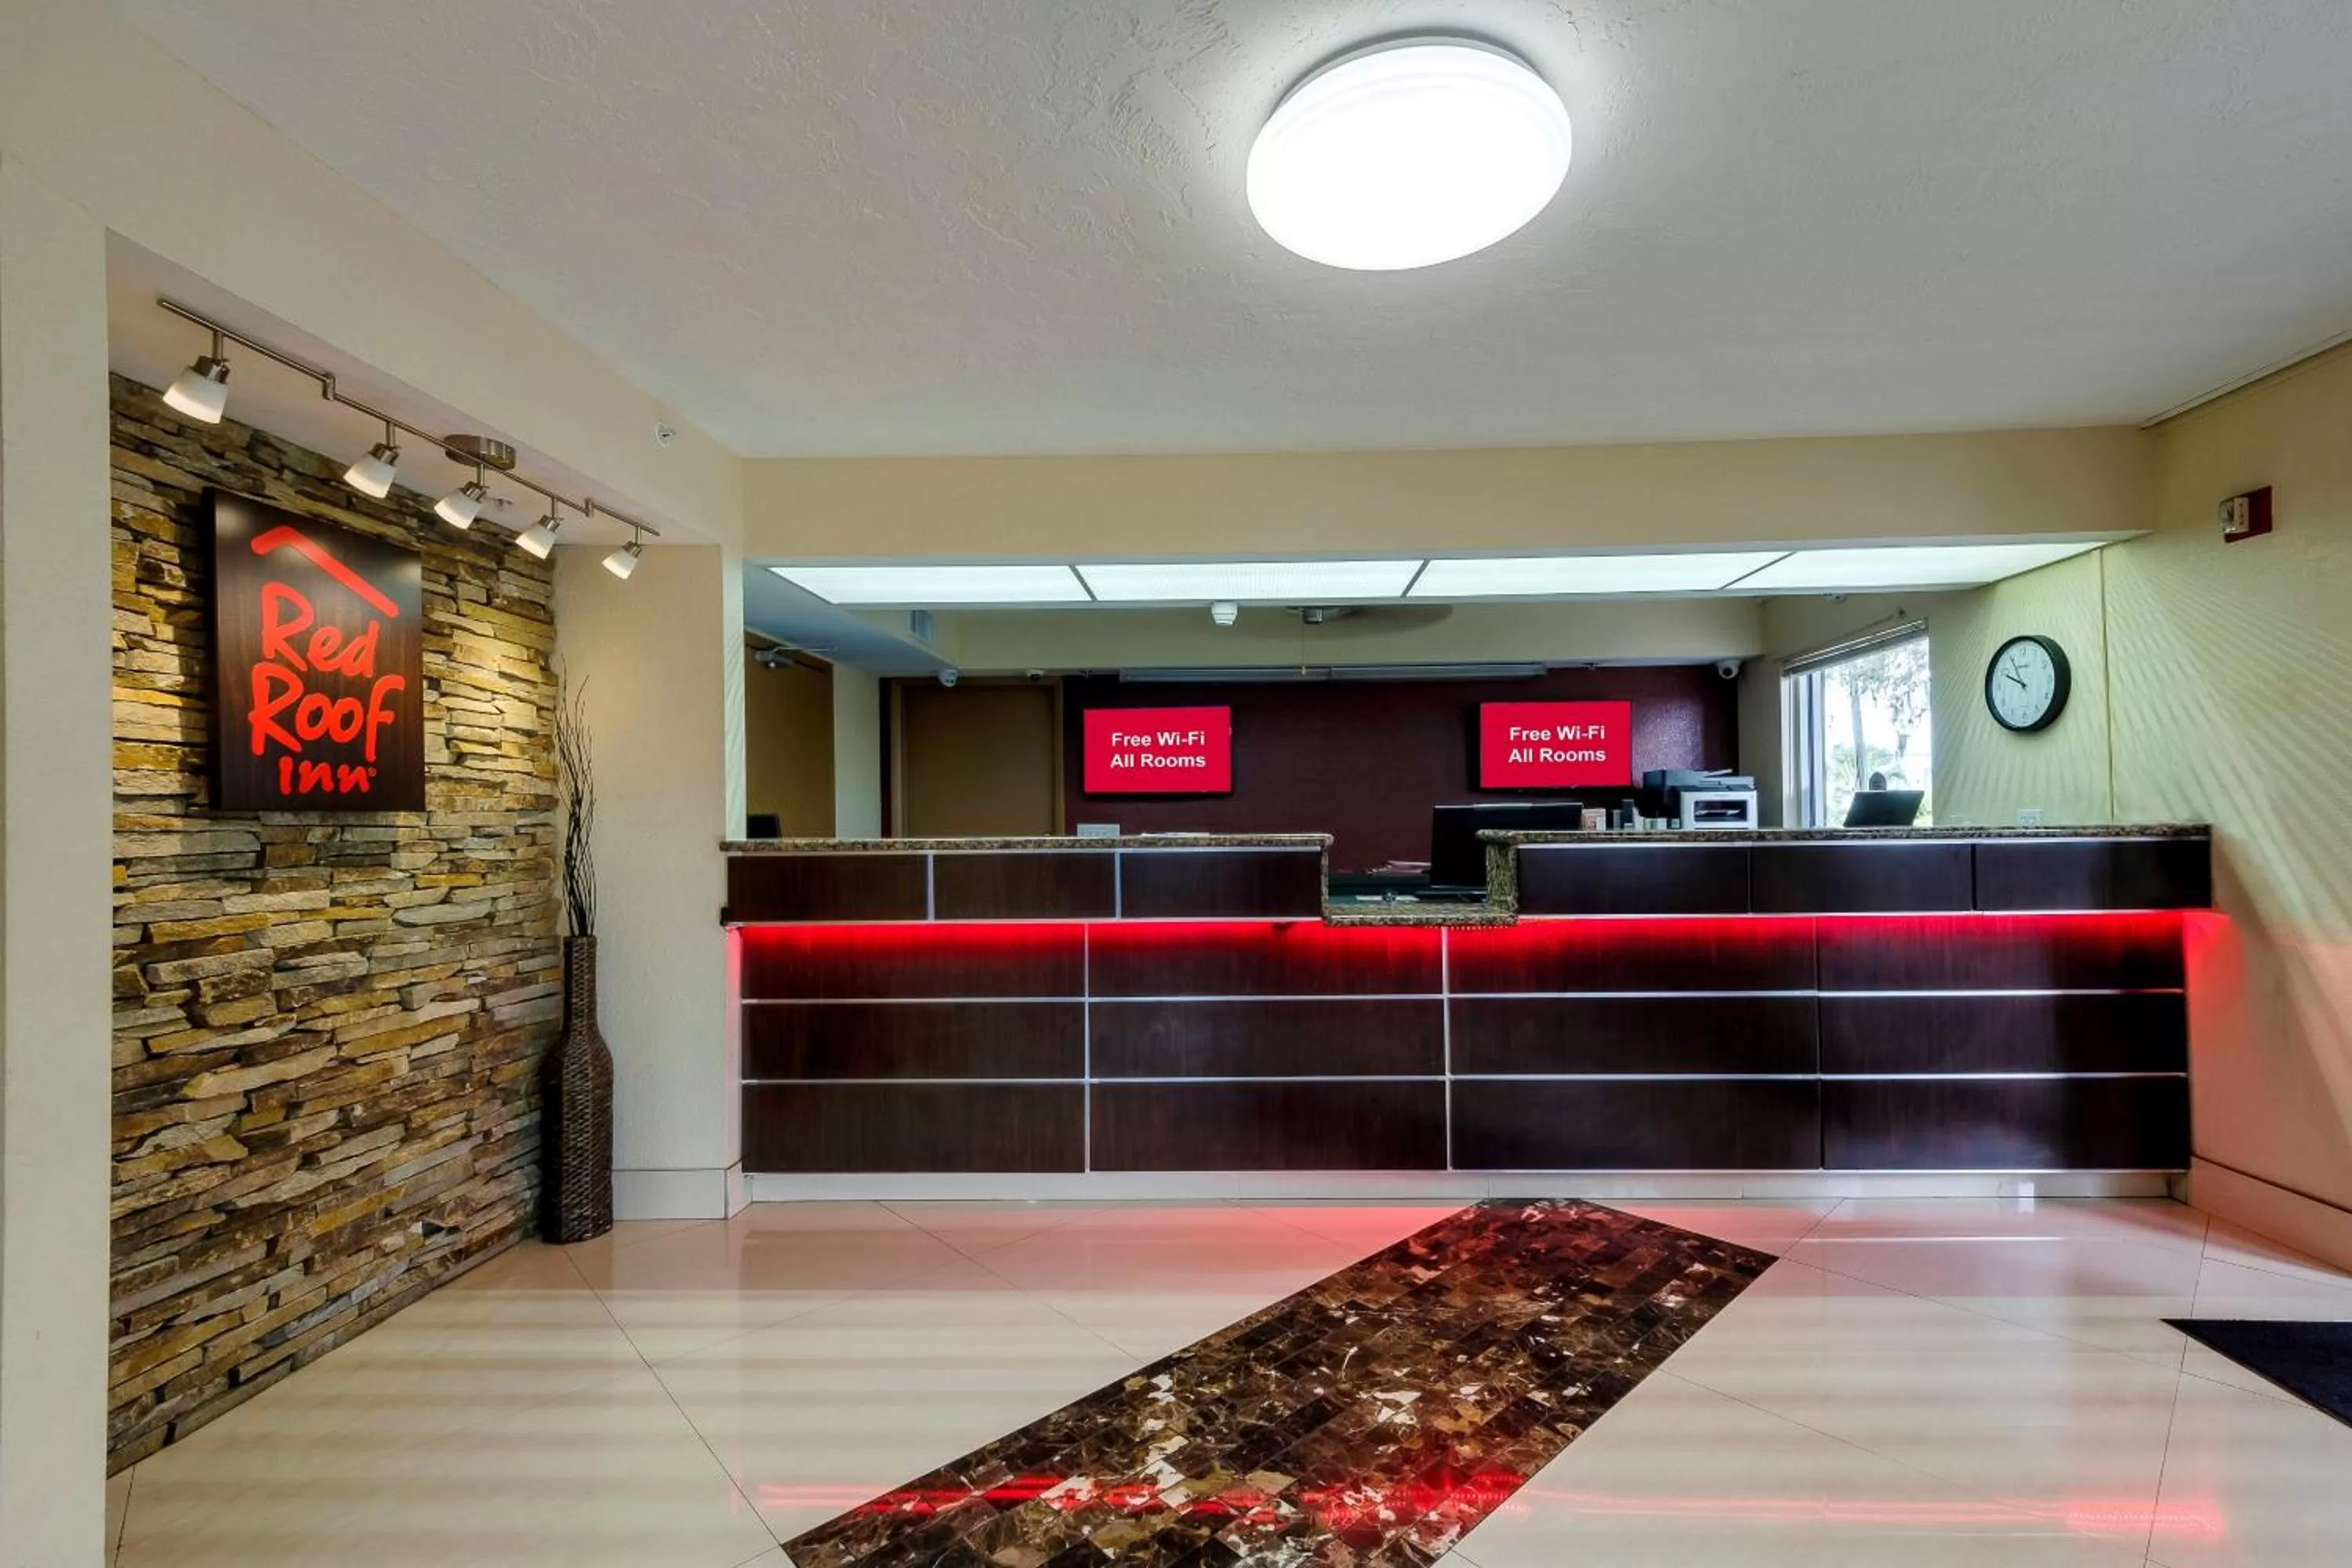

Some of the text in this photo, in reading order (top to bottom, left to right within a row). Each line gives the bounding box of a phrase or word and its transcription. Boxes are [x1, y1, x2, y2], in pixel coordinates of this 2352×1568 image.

[260, 581, 380, 678] Red
[247, 661, 406, 763] Roof
[1110, 730, 1206, 746] Free Wi-Fi
[1508, 724, 1606, 741] Free Wi-Fi
[1109, 753, 1207, 768] All Rooms
[1508, 747, 1606, 763] All Rooms
[278, 756, 371, 796] Inn
